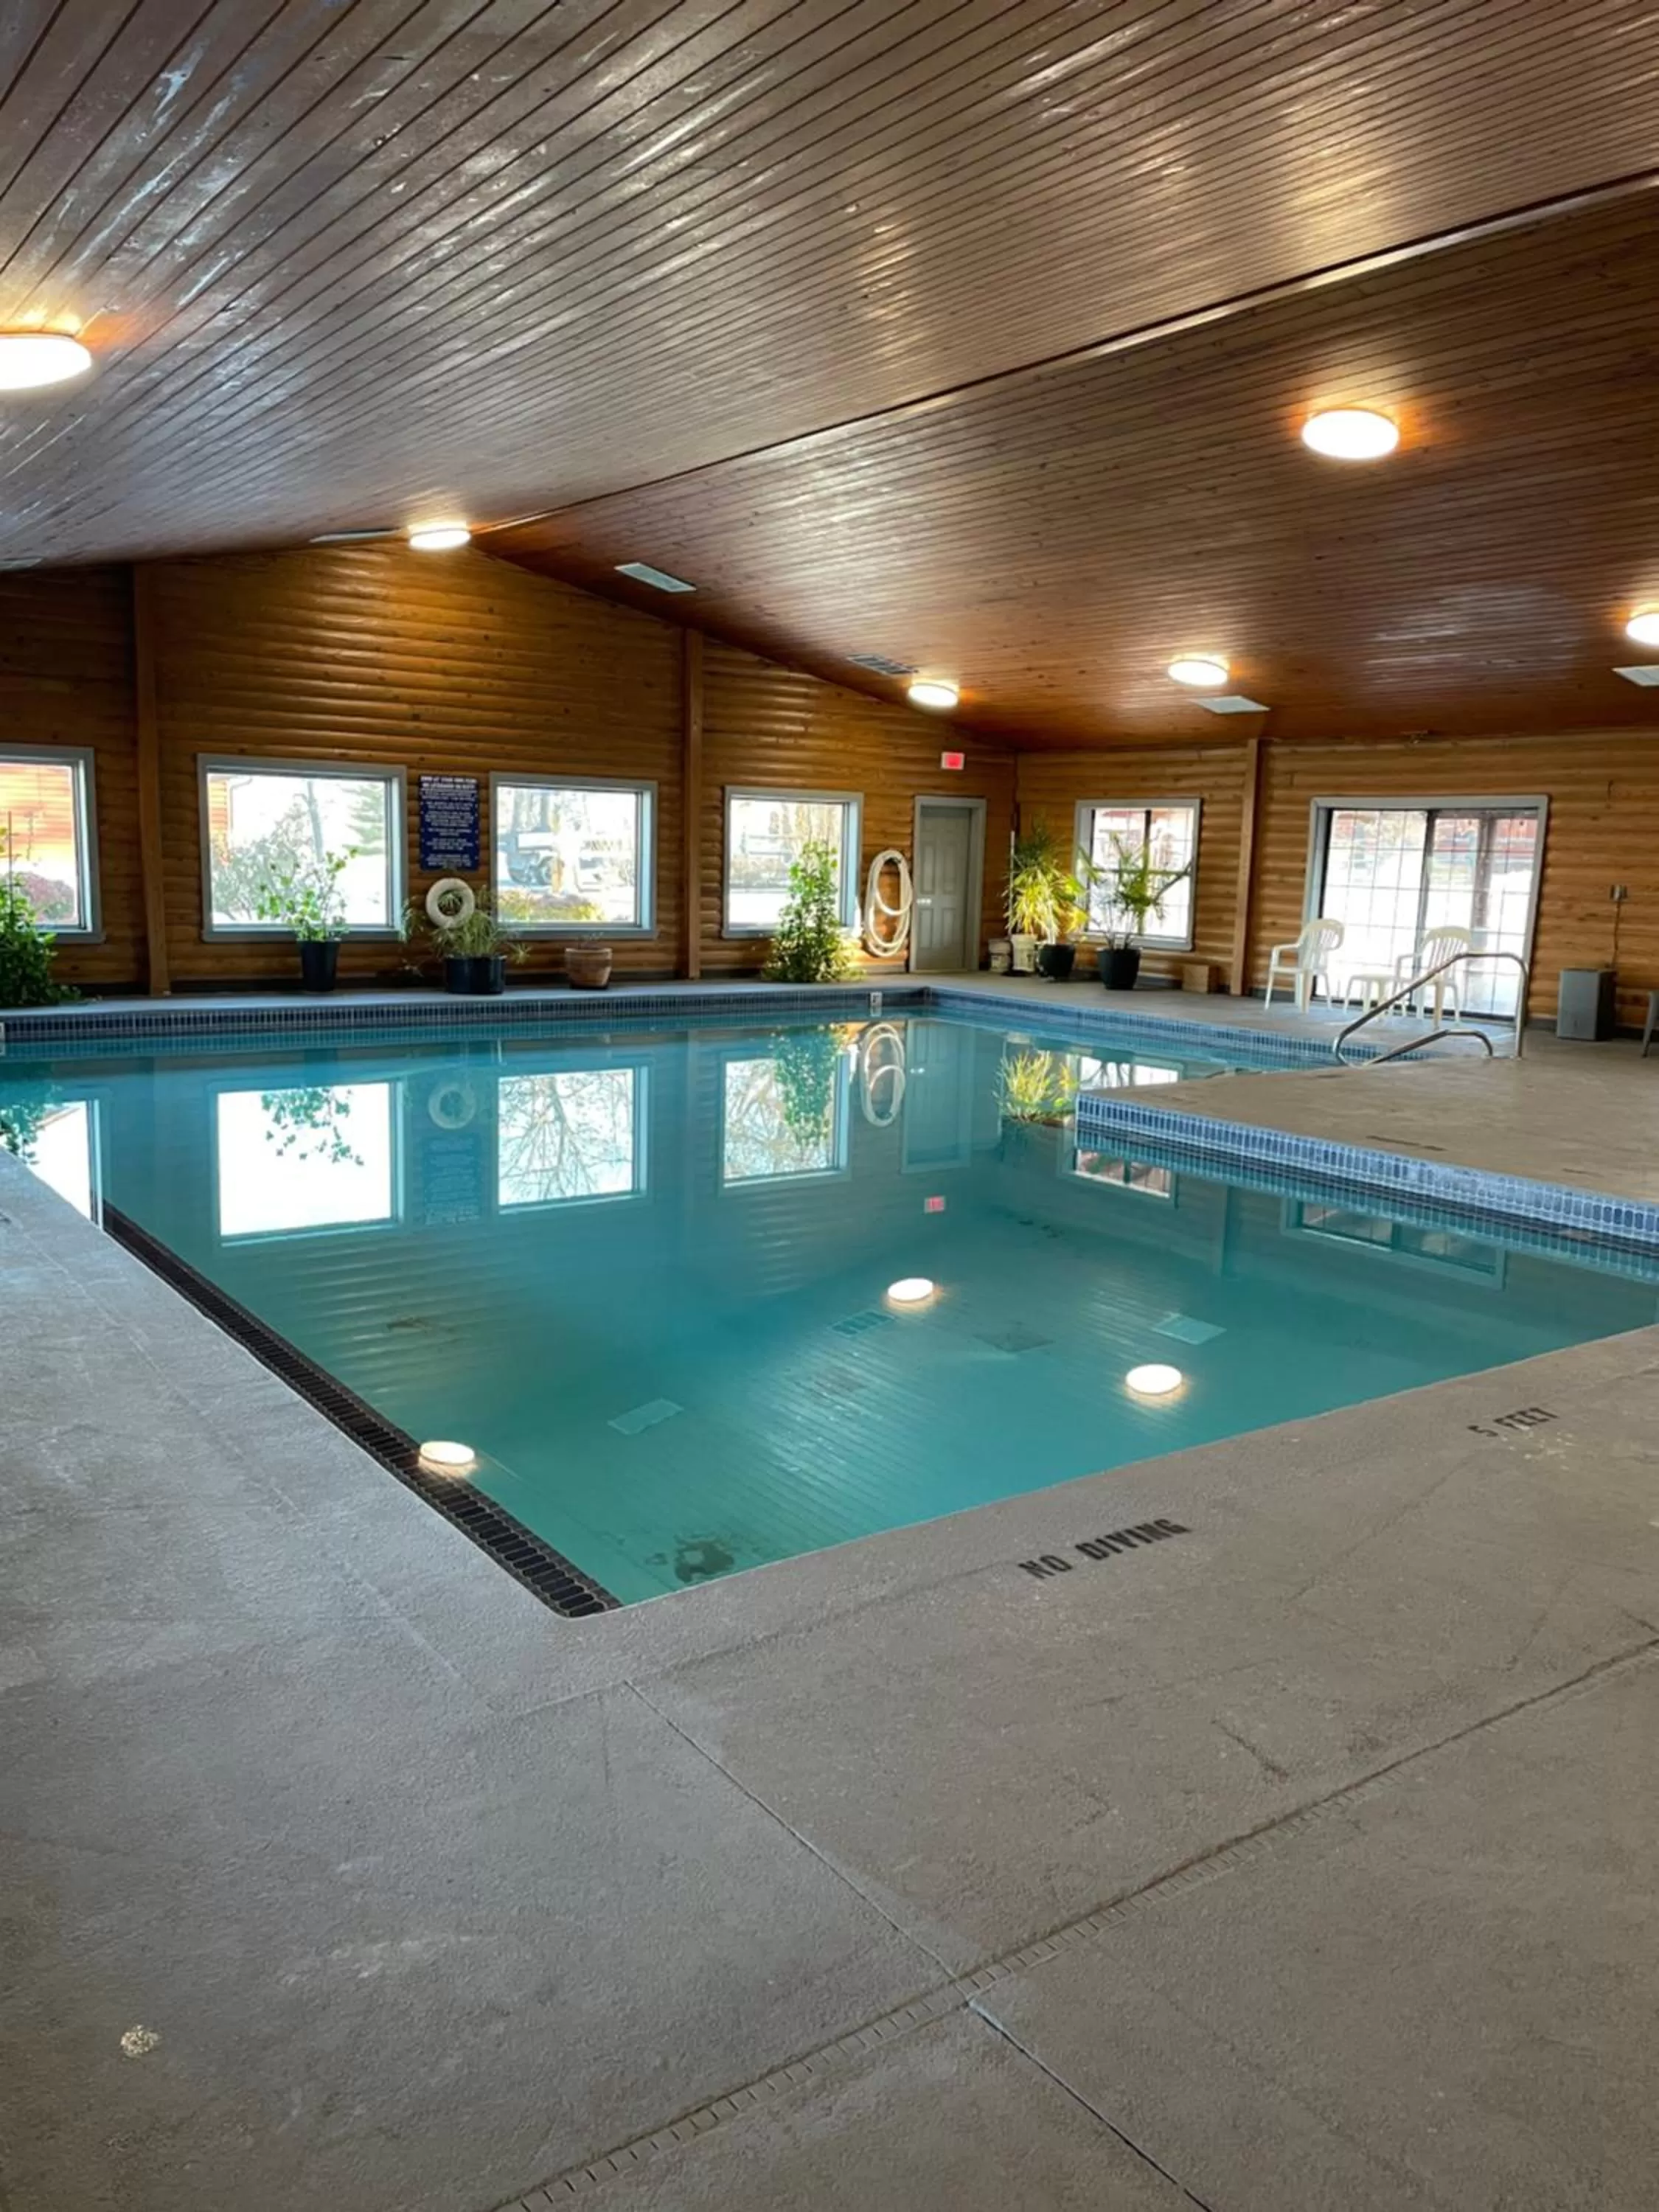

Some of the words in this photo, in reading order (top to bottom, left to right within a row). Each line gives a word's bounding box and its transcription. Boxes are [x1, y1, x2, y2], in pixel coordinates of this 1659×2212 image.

[1467, 1425, 1498, 1437] 5
[1493, 1408, 1558, 1430] FEET
[1018, 1555, 1073, 1579] NO
[1075, 1519, 1192, 1560] DIVING
